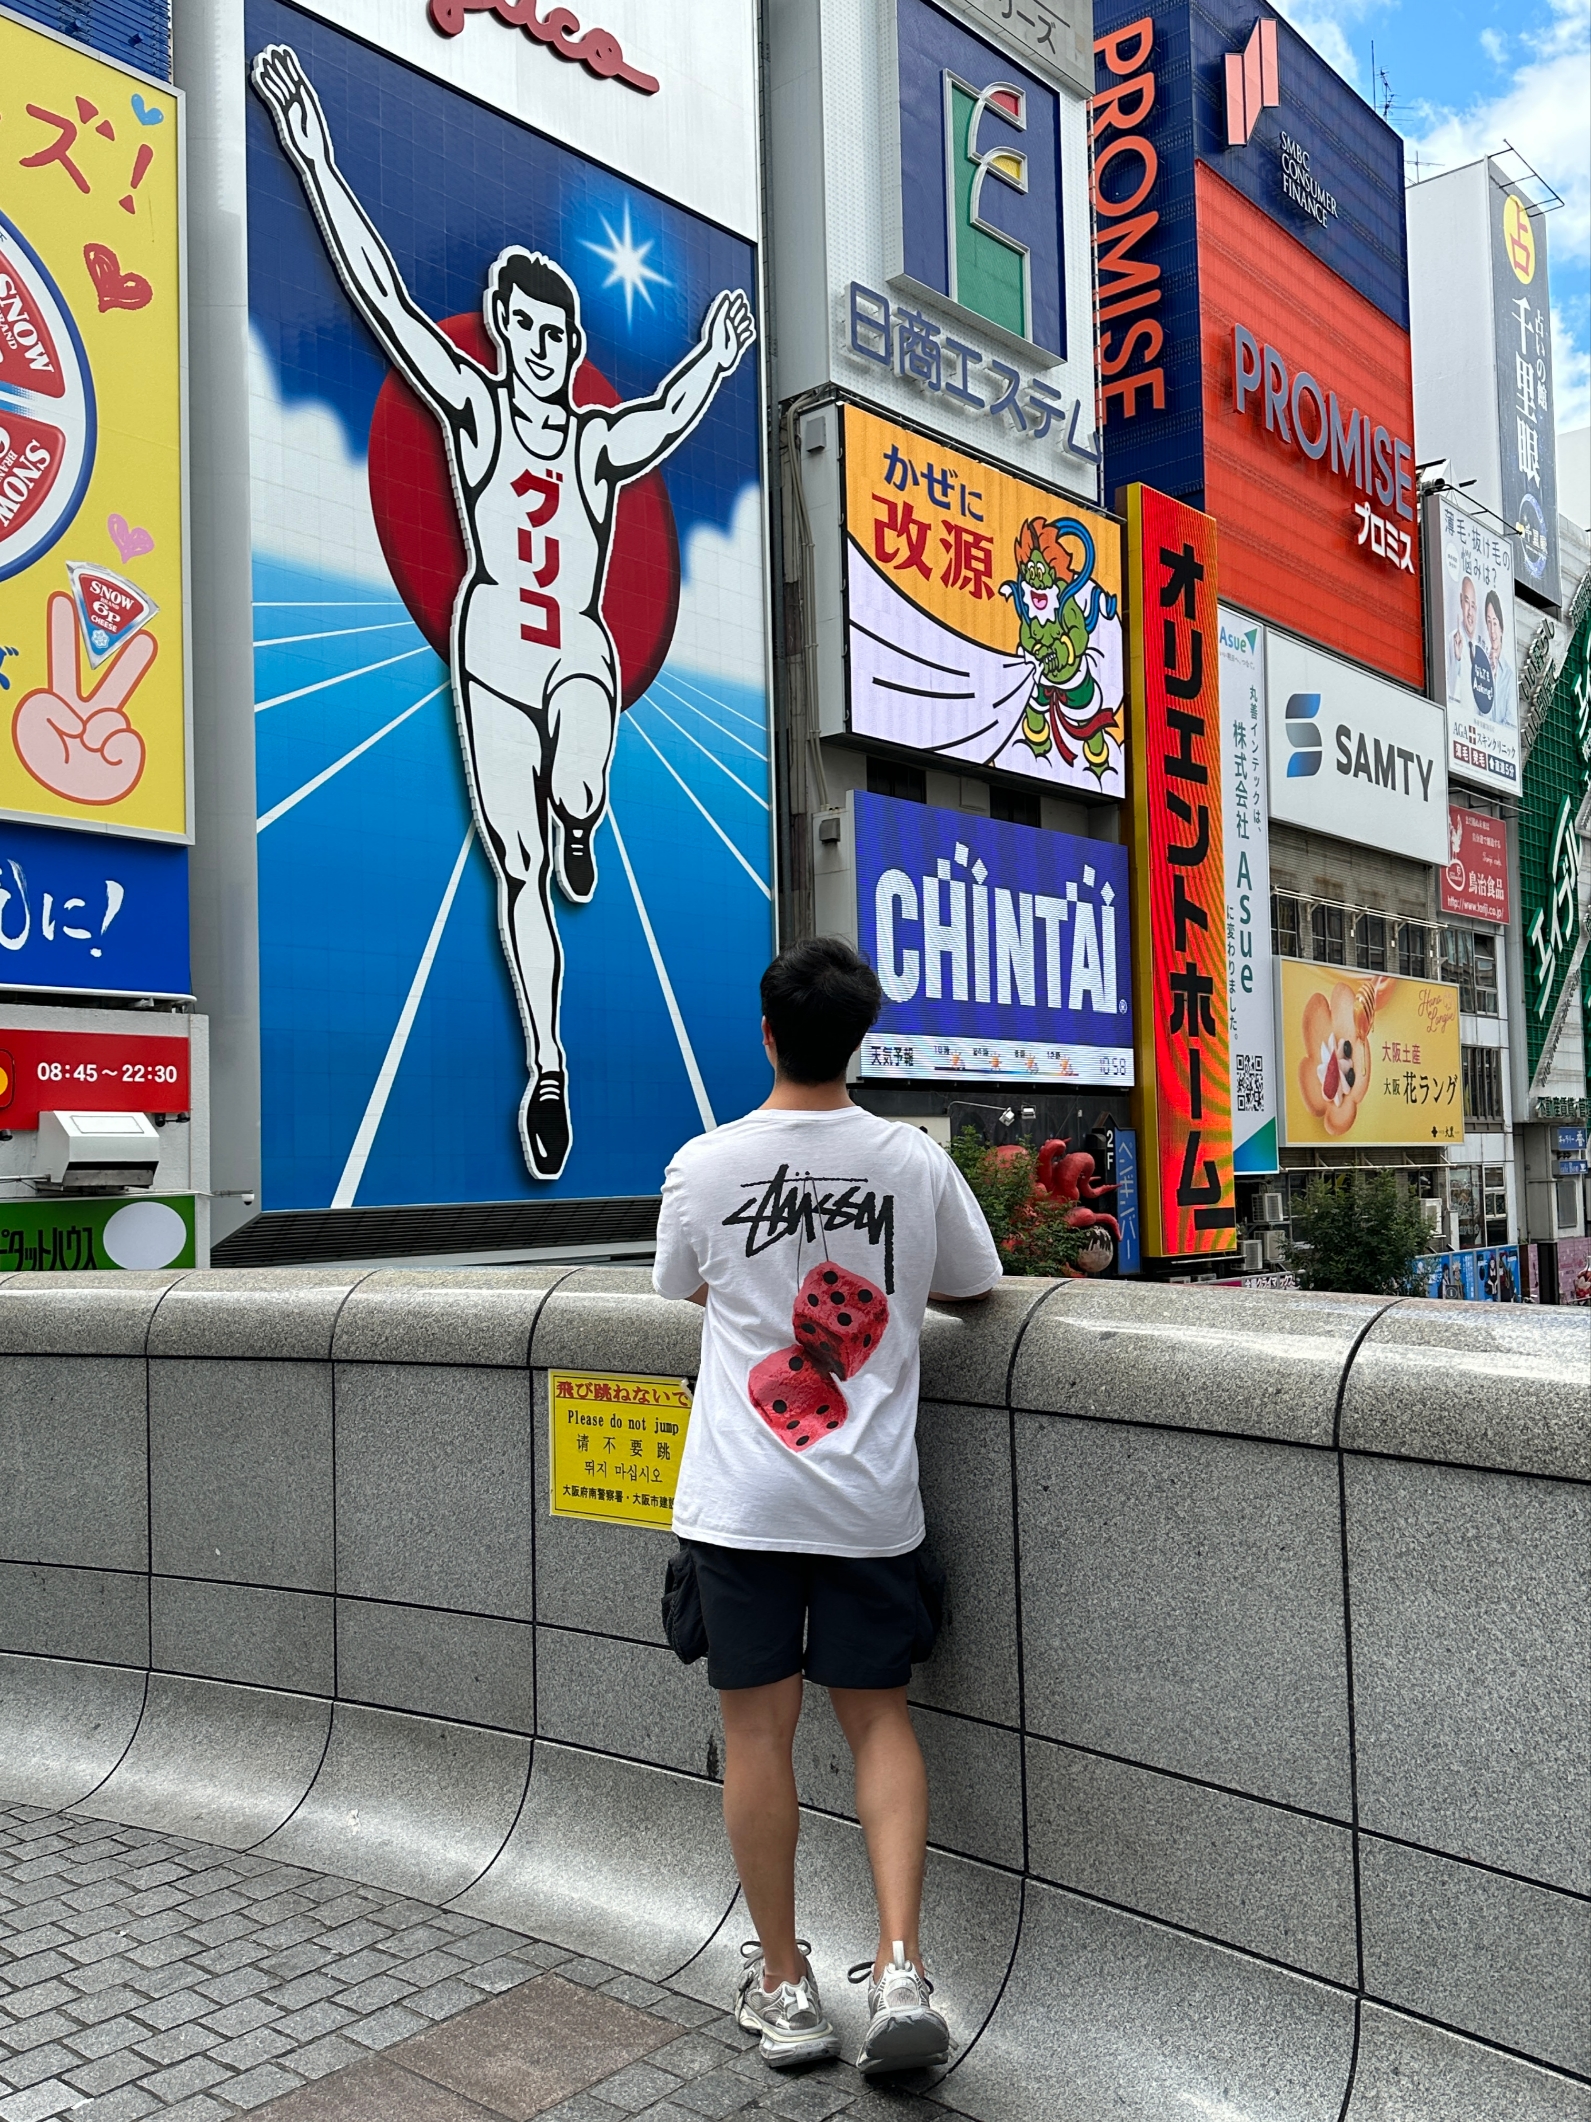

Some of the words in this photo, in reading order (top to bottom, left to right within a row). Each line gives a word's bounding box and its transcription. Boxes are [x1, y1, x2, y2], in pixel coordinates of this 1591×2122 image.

[1280, 131, 1310, 171] SMBC
[1281, 153, 1338, 219] CONSUMER
[1282, 173, 1328, 229] FINANCE
[1088, 16, 1166, 429] PROMISE
[1232, 322, 1413, 522] PROMISE
[882, 443, 985, 522] かぜに
[509, 467, 563, 650] グリコ
[871, 492, 996, 601] 改源
[1355, 501, 1415, 574] プロミス
[90, 580, 135, 611] SNOW
[90, 614, 118, 633] CHEESE
[92, 600, 121, 624] 6P
[1219, 625, 1247, 653] Asue
[1232, 719, 1250, 840] 株式会社
[1335, 724, 1433, 802] SAMTY
[1236, 851, 1253, 994] Asue
[871, 1045, 914, 1066] 天気予報
[1381, 1041, 1421, 1065] 大阪土産
[567, 1410, 604, 1427] Please
[610, 1413, 623, 1429] do
[628, 1417, 646, 1431] not
[653, 1417, 679, 1435] jump
[585, 1459, 607, 1478] 뛰지
[615, 1463, 663, 1483] 마십시오
